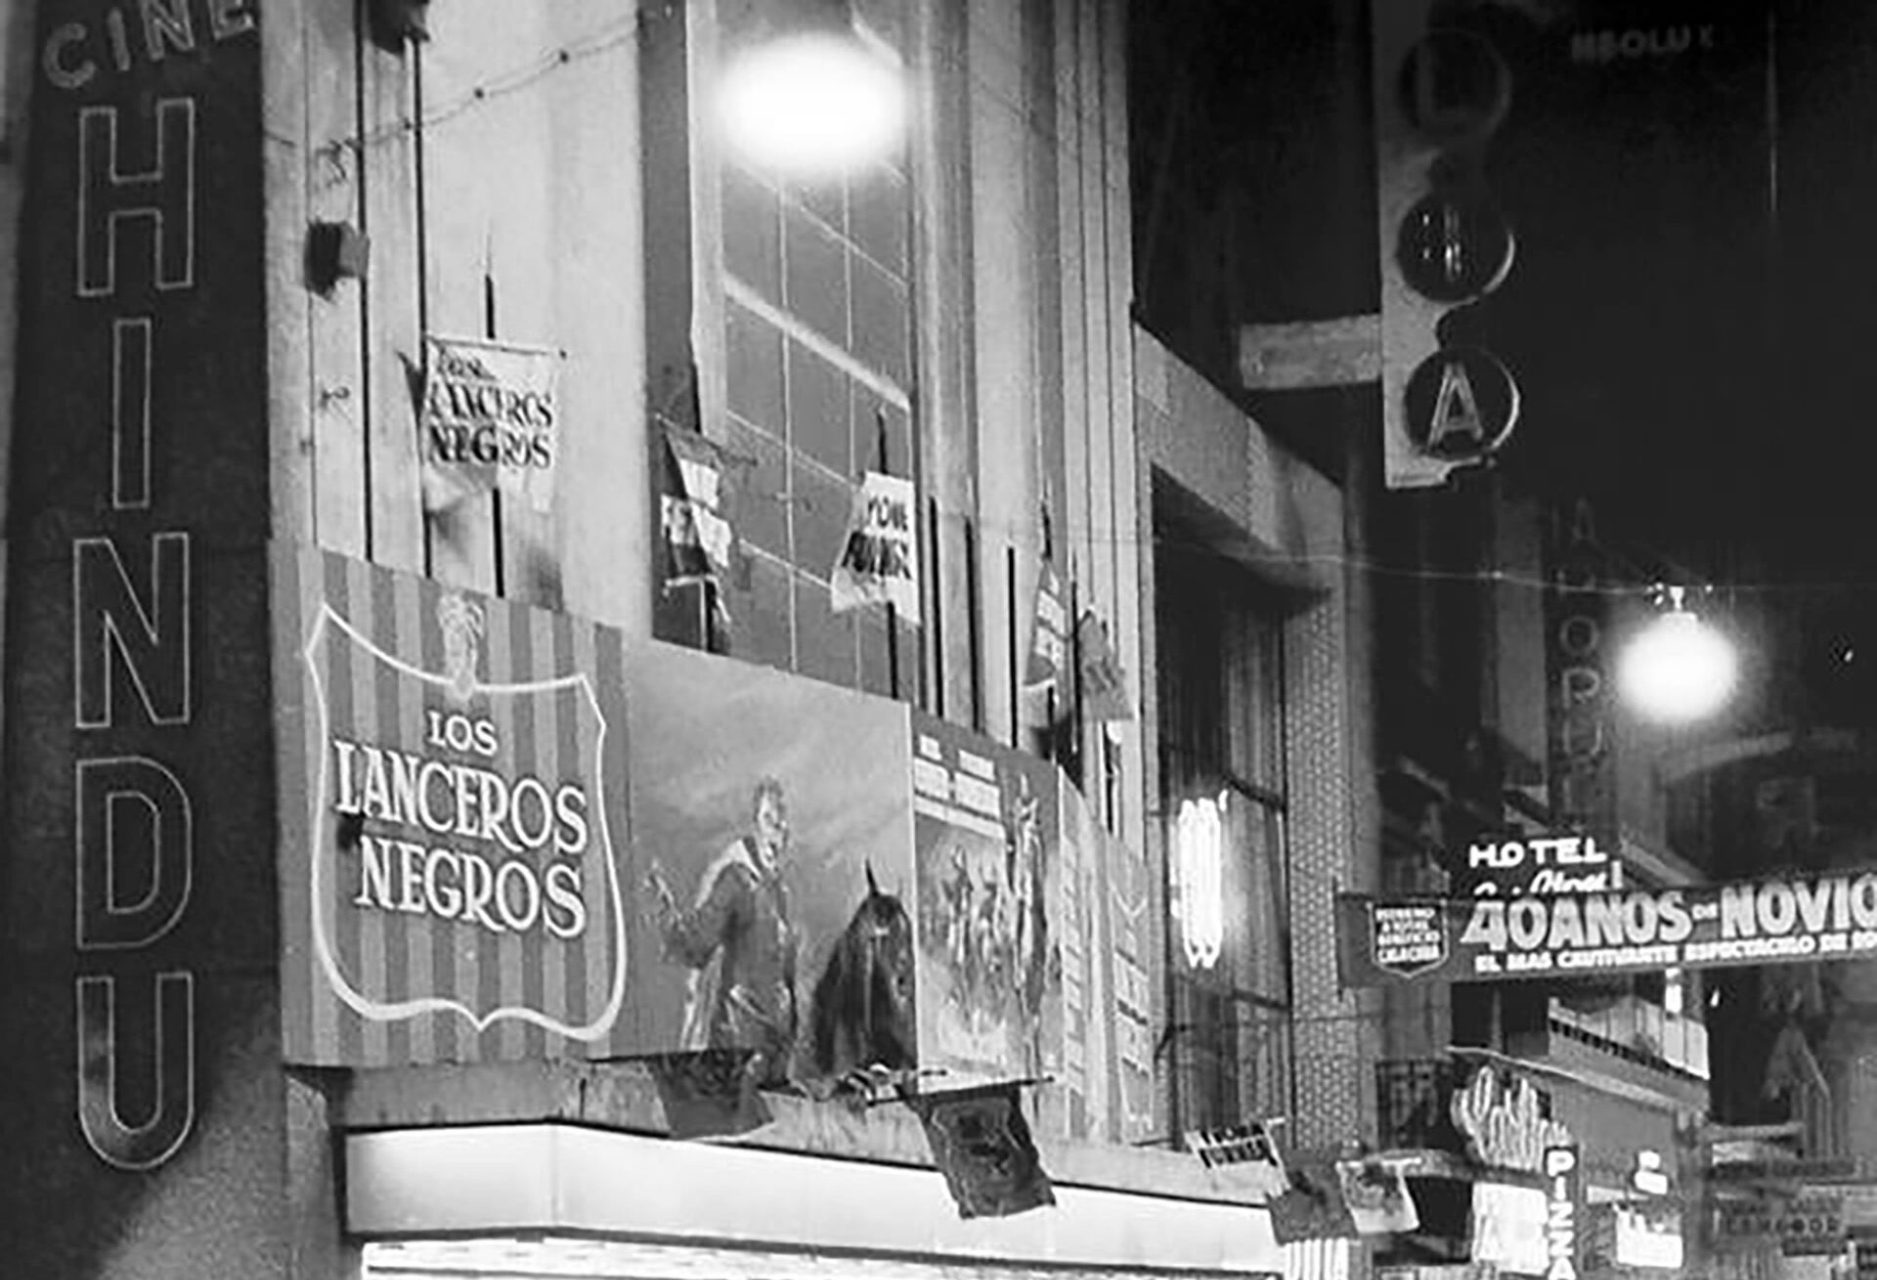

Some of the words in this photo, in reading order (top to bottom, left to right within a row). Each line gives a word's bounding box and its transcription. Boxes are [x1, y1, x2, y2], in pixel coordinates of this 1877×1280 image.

[43, 0, 255, 88] CINE
[427, 422, 552, 470] NEGROS
[77, 98, 194, 1170] HINDU
[428, 710, 498, 756] LOS
[334, 739, 588, 855] LANCEROS
[353, 836, 587, 938] NEGROS
[1469, 837, 1608, 868] HOTEL
[1547, 1149, 1578, 1279] PIZZA
